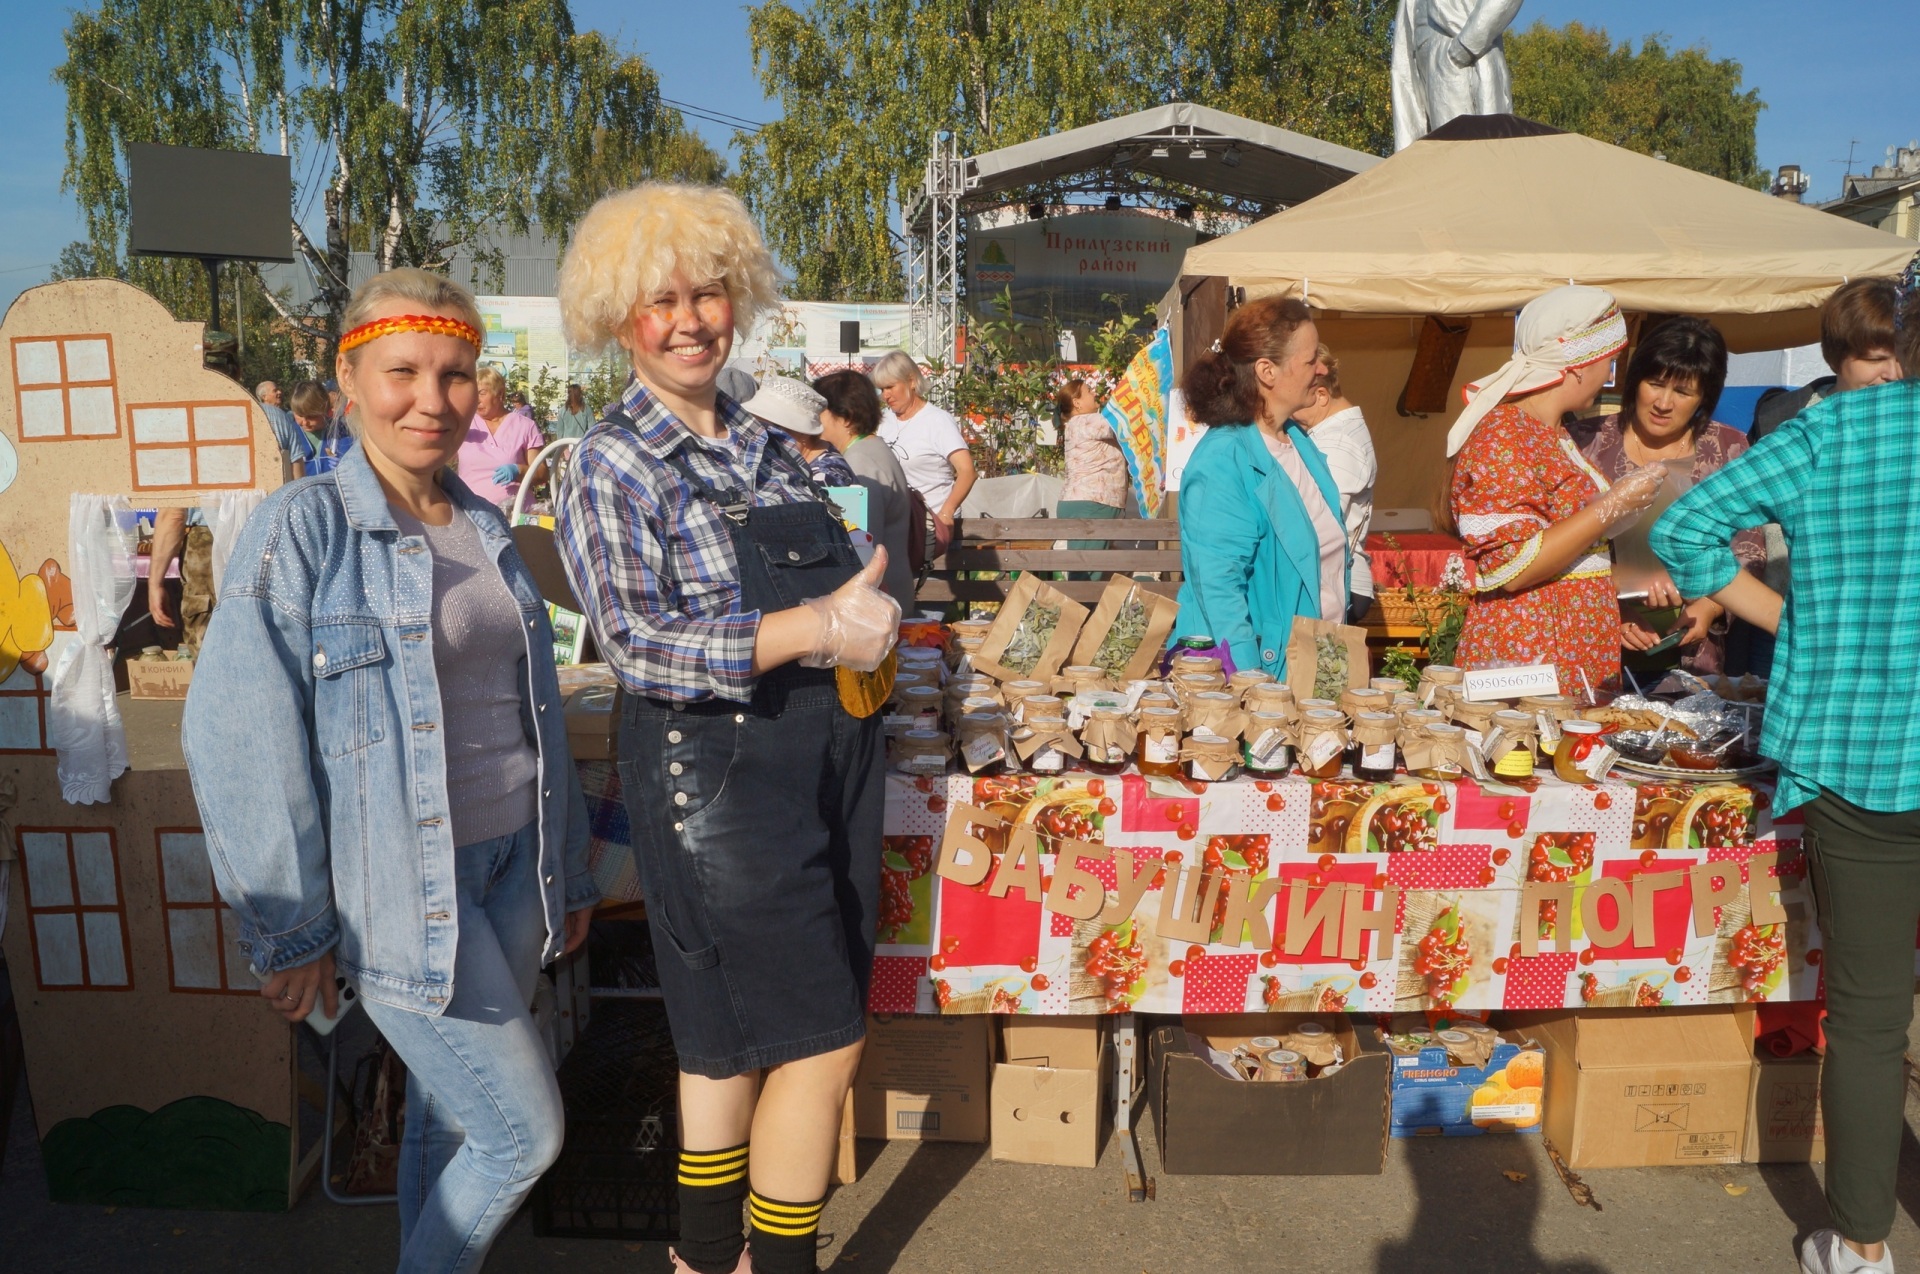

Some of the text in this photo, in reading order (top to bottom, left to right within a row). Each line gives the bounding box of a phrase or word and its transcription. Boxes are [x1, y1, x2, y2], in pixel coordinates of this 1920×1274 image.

[1046, 232, 1170, 260] Прилузский
[1080, 257, 1137, 275] район
[1469, 672, 1554, 690] 89505667978
[935, 800, 1806, 960] БАБУШКИН ПОГРЕ
[1402, 1068, 1459, 1079] FRESHGRO
